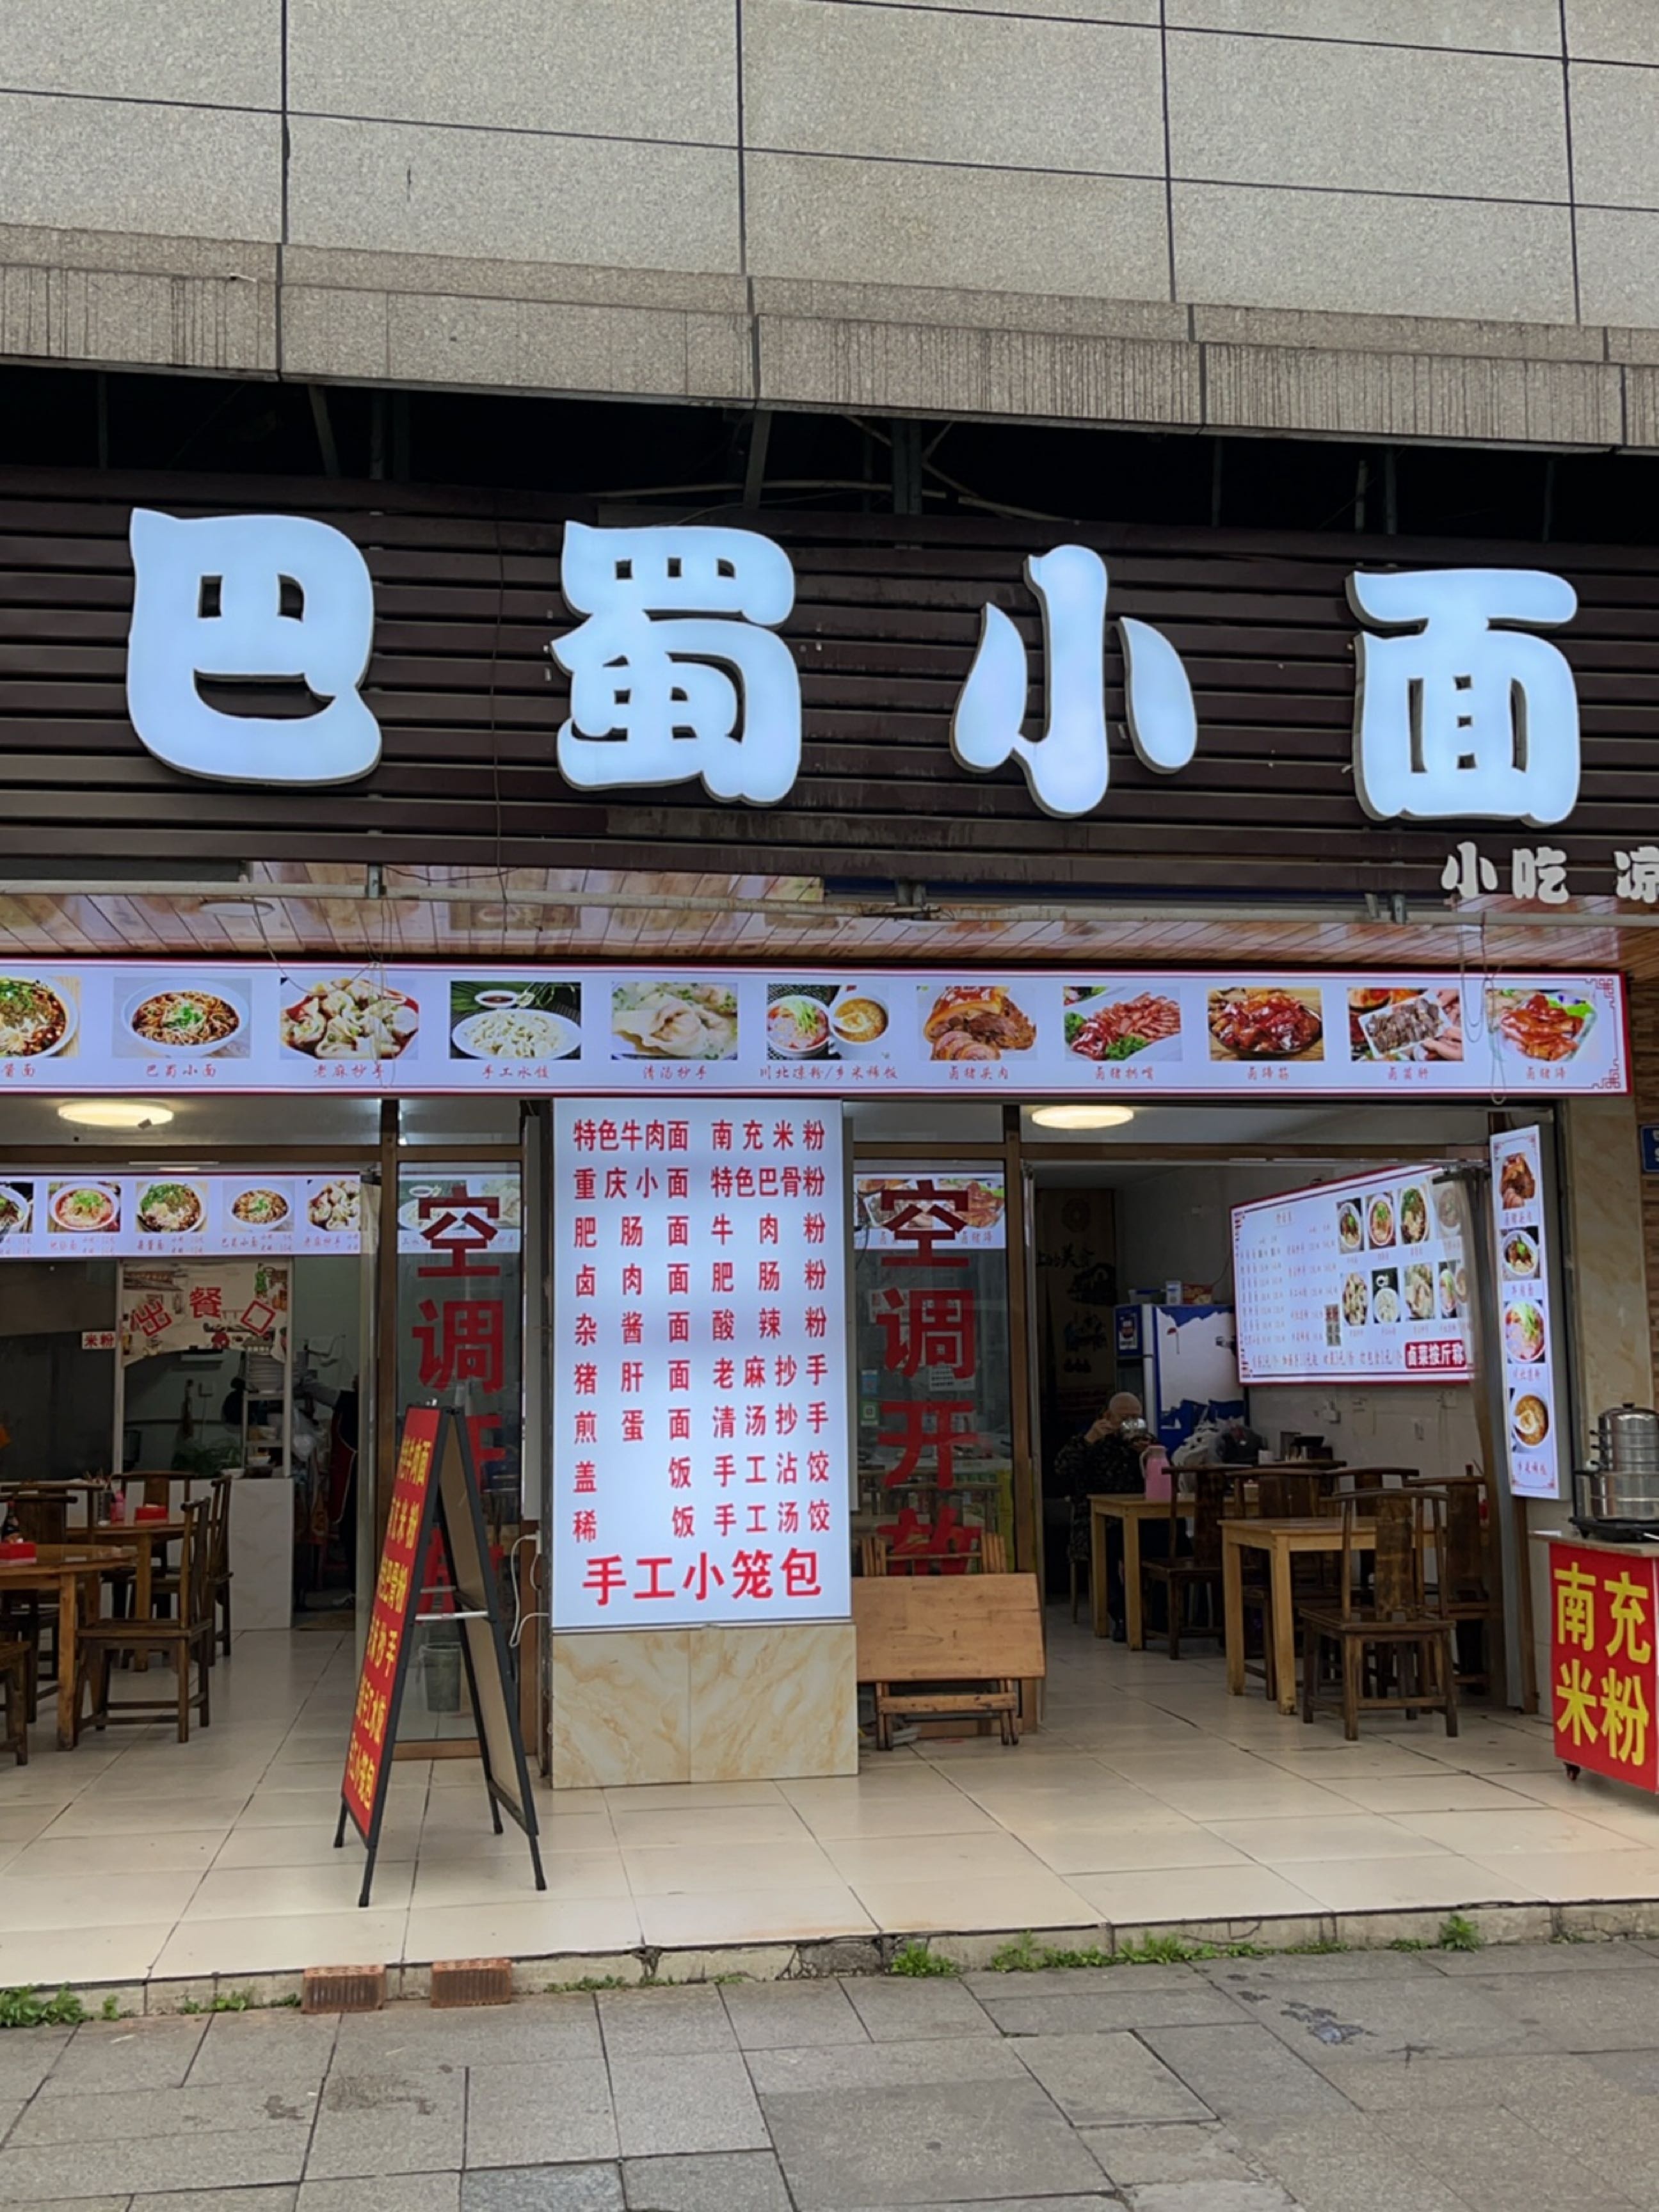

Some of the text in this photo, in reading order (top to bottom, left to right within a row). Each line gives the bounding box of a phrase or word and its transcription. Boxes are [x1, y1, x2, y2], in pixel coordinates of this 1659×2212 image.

[127, 507, 1581, 826] 巴蜀小面
[1441, 841, 1570, 904] 小吃
[146, 1062, 217, 1078] 巴蜀小面
[314, 1062, 384, 1079] 老麻抄手
[481, 1064, 550, 1080] 手工水饺
[643, 1065, 707, 1080] 清汤抄手
[573, 1119, 689, 1151] 特色牛肉面
[711, 1119, 825, 1151] 南充米粉
[573, 1167, 689, 1199] 重庆小面
[710, 1166, 825, 1198] 特色巴骨粉
[574, 1215, 689, 1247] 肥肠面
[711, 1213, 826, 1246] 牛肉粉
[576, 1263, 689, 1297] 卤肉面
[712, 1259, 826, 1292] 肥肠粉
[130, 1286, 276, 1336] 出餐口
[712, 1306, 826, 1340] 酸辣粉
[84, 1333, 115, 1347] 米粉
[575, 1311, 690, 1346] 杂酱面
[575, 1359, 691, 1395] 猪肝面
[713, 1354, 828, 1390] 老麻抄手
[575, 1409, 691, 1444] 煎蛋面
[712, 1401, 829, 1439] 清汤抄手
[714, 1450, 830, 1488] 手工沾饺
[714, 1499, 830, 1537] 手工汤饺
[582, 1547, 822, 1607] 手工小笼包
[1553, 1562, 1652, 1665] 南充
[1555, 1658, 1650, 1767] 米粉
